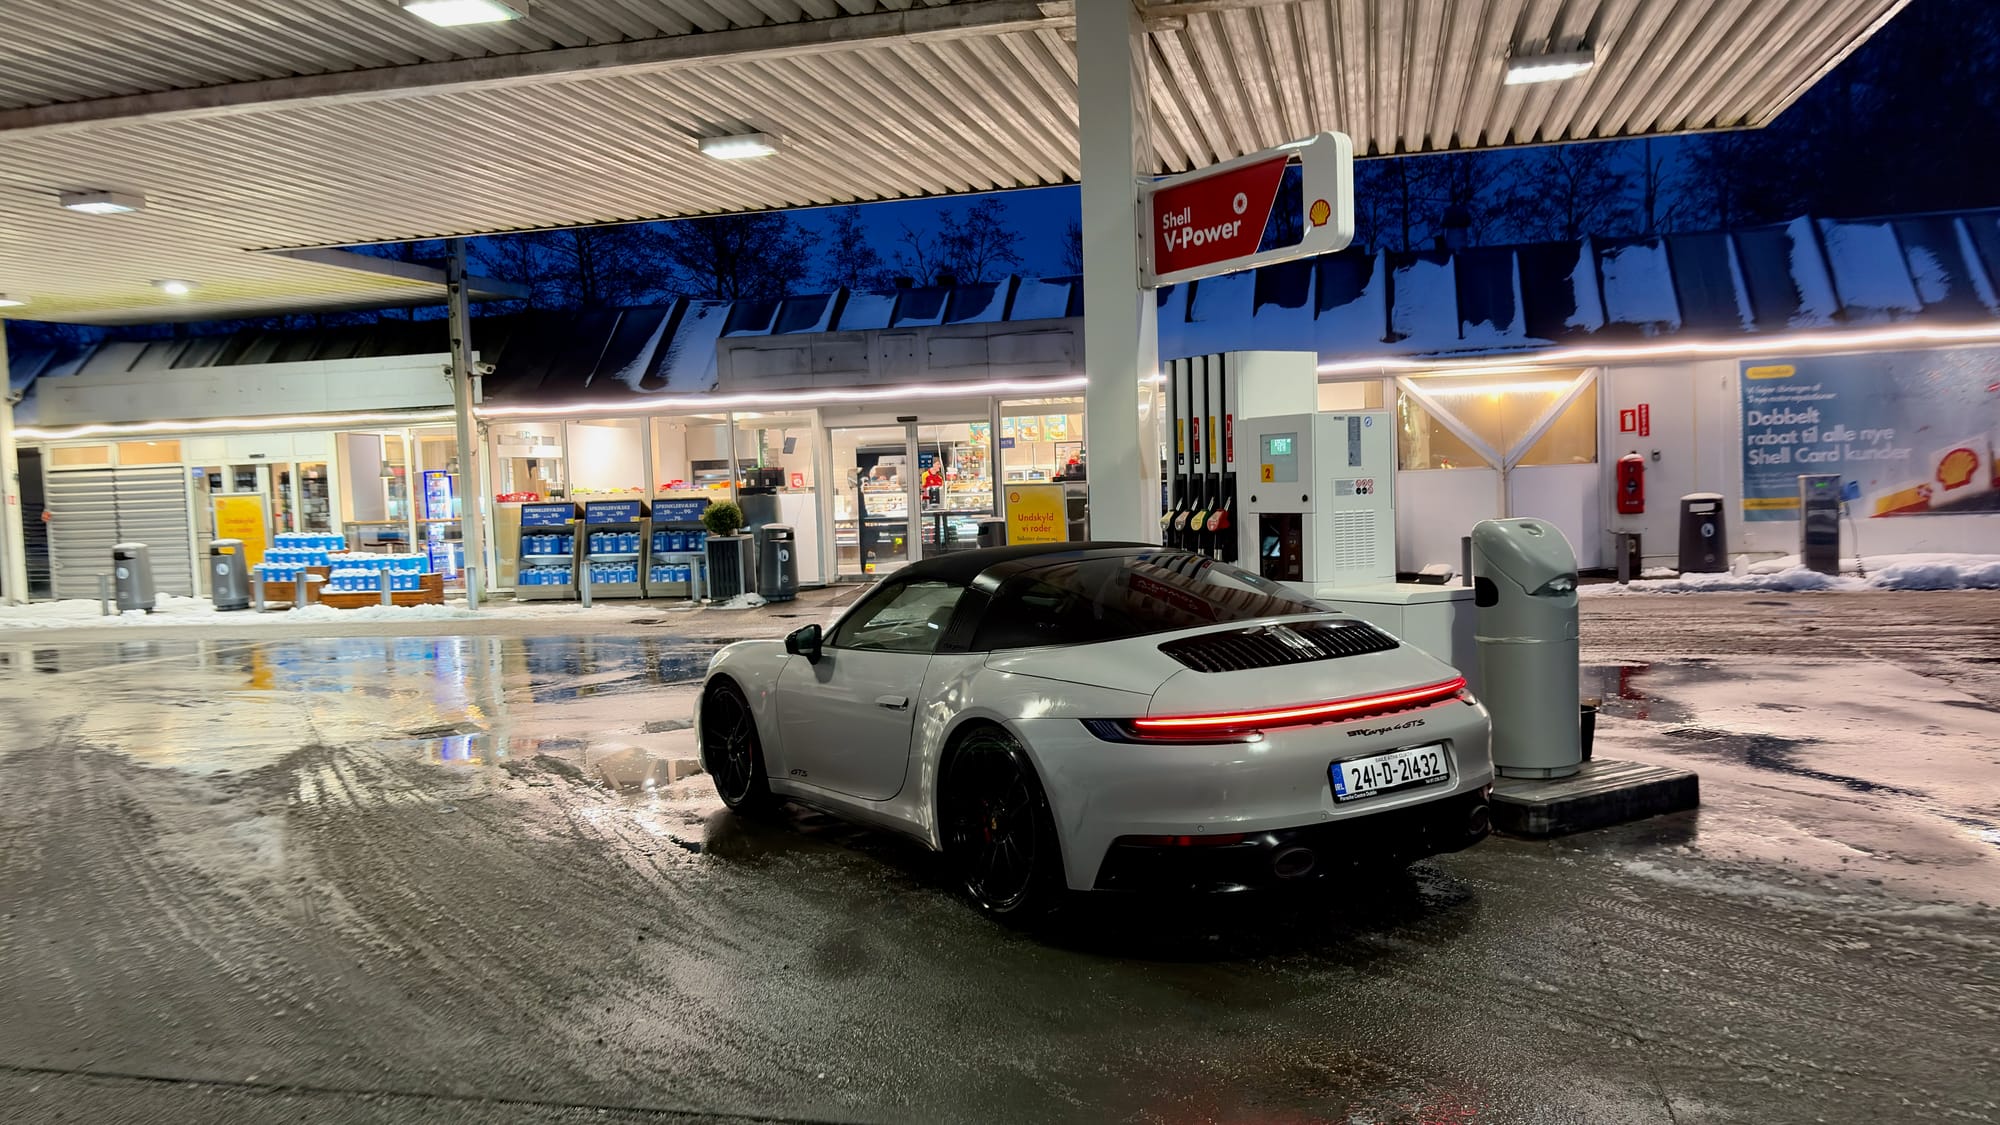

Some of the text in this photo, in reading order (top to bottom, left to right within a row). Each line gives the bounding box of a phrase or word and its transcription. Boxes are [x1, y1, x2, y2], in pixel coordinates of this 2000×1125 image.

[1163, 206, 1191, 229] Shell
[1163, 219, 1241, 252] V-Power
[1747, 406, 1821, 426] Dobbelt
[1748, 424, 1895, 446] rabat til alle nye
[1749, 443, 1913, 465] Shell Card kunder
[1265, 468, 1271, 479] 2
[1018, 512, 1054, 523] Undskyld
[1030, 524, 1051, 532] roder
[1363, 727, 1392, 736] Targa
[1402, 719, 1426, 729] GTS
[790, 768, 808, 777] GTS
[1352, 753, 1440, 790] 241-D-21432
[1334, 783, 1345, 791] IRL
